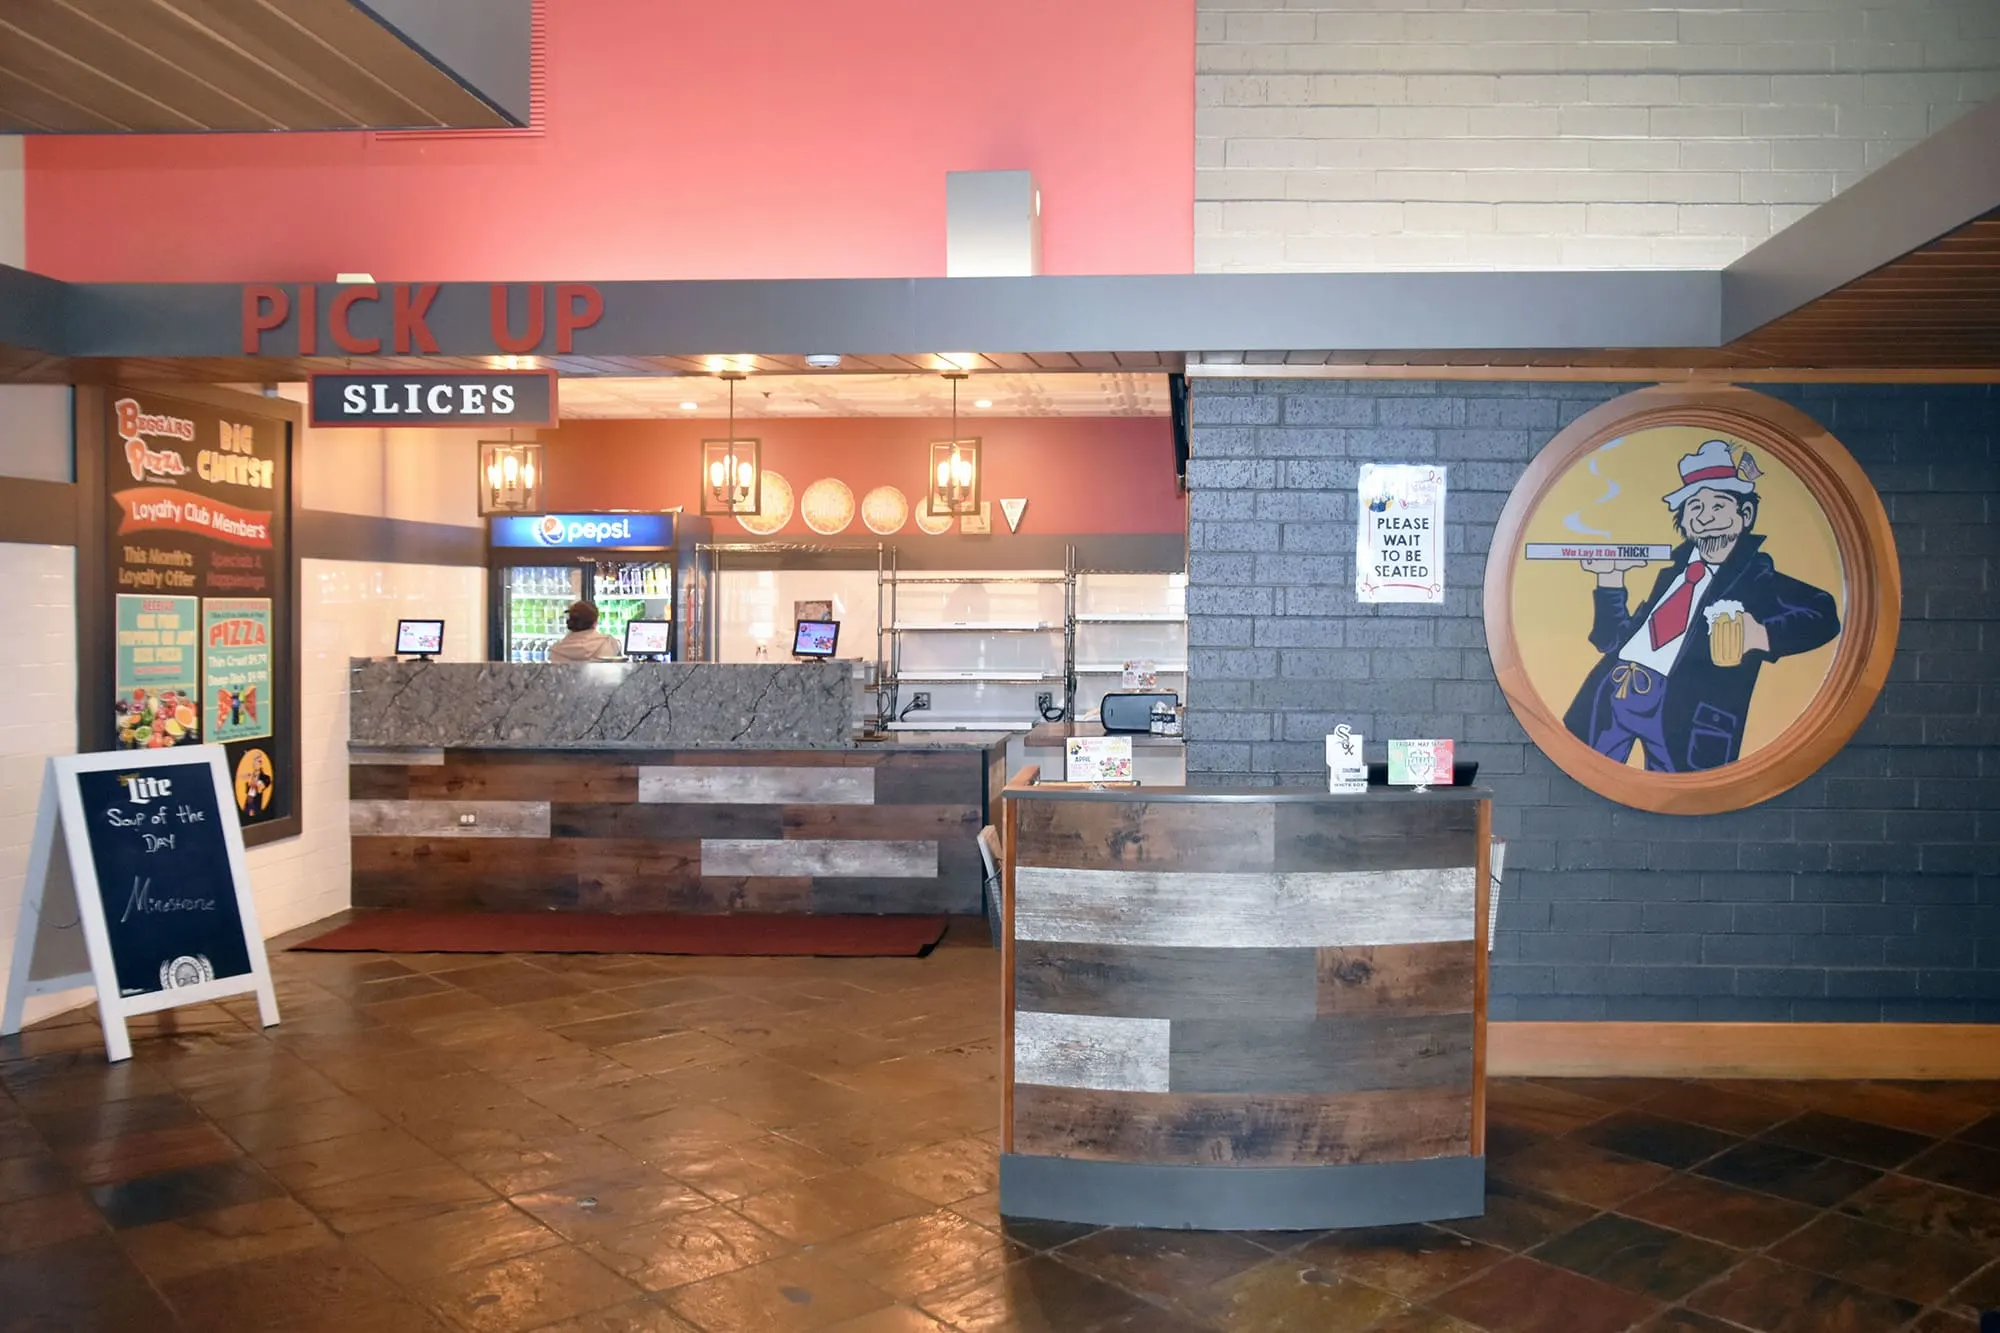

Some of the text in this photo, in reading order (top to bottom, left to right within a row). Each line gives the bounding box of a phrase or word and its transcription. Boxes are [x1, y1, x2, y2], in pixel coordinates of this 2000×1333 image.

[241, 284, 603, 354] PICK UP
[342, 384, 516, 414] SLICES
[131, 500, 266, 539] Loyalty Club Members
[568, 518, 631, 543] pepsi
[1377, 518, 1429, 530] PLEASE
[1384, 535, 1420, 546] WAIT
[122, 545, 147, 564] This
[1382, 550, 1422, 562] TO BE
[1561, 548, 1576, 557] We
[1578, 548, 1594, 558] Lay
[1604, 548, 1616, 557] On
[1617, 546, 1649, 558] THICK!
[119, 566, 196, 589] Loyalty Offer
[1375, 565, 1428, 578] SEATED
[209, 618, 268, 648] PIZZA
[127, 777, 172, 804] Lite
[151, 806, 168, 825] of
[176, 804, 206, 824] the
